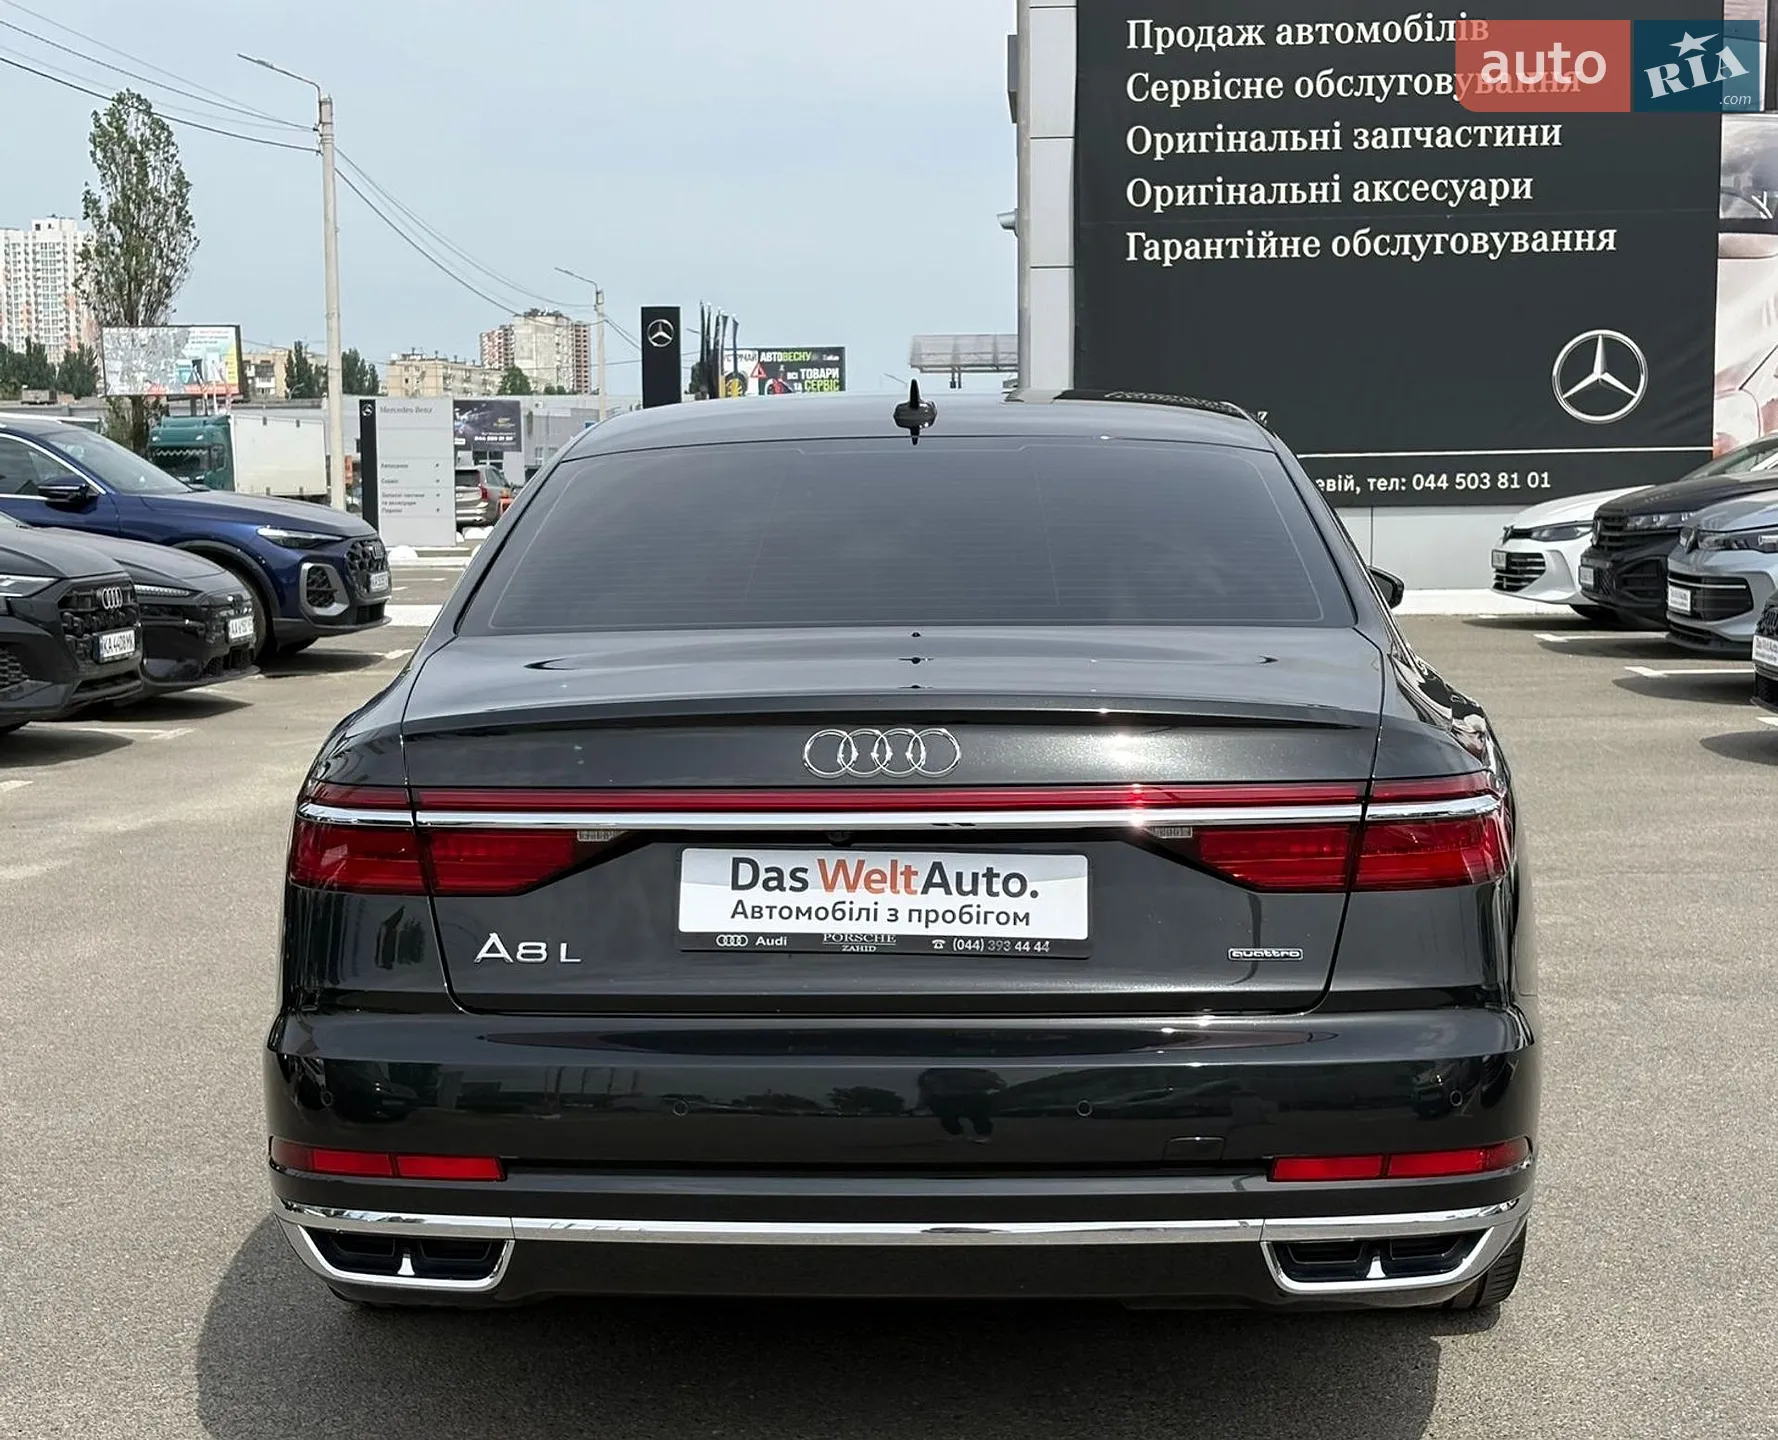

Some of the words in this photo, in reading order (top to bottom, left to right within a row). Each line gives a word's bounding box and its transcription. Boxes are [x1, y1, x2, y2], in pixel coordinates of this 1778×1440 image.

[1126, 19, 1265, 55] Продаж
[1276, 12, 1489, 47] автомобілів
[1126, 70, 1284, 108] Сервісне
[1126, 121, 1342, 161] Оригінальні
[1353, 119, 1563, 150] запчастини
[1126, 174, 1342, 214] Оригінальні
[1352, 174, 1534, 208] аксесуари
[1126, 229, 1321, 266] Гарантійне
[1331, 226, 1618, 262] обслуговування
[800, 367, 839, 379] ТОВАРИ
[804, 380, 839, 392] СЕРВІС
[1366, 476, 1407, 491] тел:
[1412, 474, 1449, 490] 044
[1454, 473, 1491, 489] 503
[1497, 472, 1521, 489] 81
[1527, 471, 1551, 488] 01
[731, 856, 809, 893] Das
[816, 858, 1039, 899] WeltAuto.
[730, 899, 879, 923] Автомобілі
[886, 907, 899, 923] з
[908, 904, 1030, 929] пробігом
[474, 932, 548, 963] A8
[559, 942, 582, 963] L
[755, 935, 787, 946] Audi
[822, 933, 896, 944] PORSCHE
[953, 937, 984, 951] (044)
[987, 940, 1011, 951] 393
[1014, 940, 1031, 952] 44
[1033, 941, 1050, 953] 44
[1232, 950, 1300, 959] quattro
